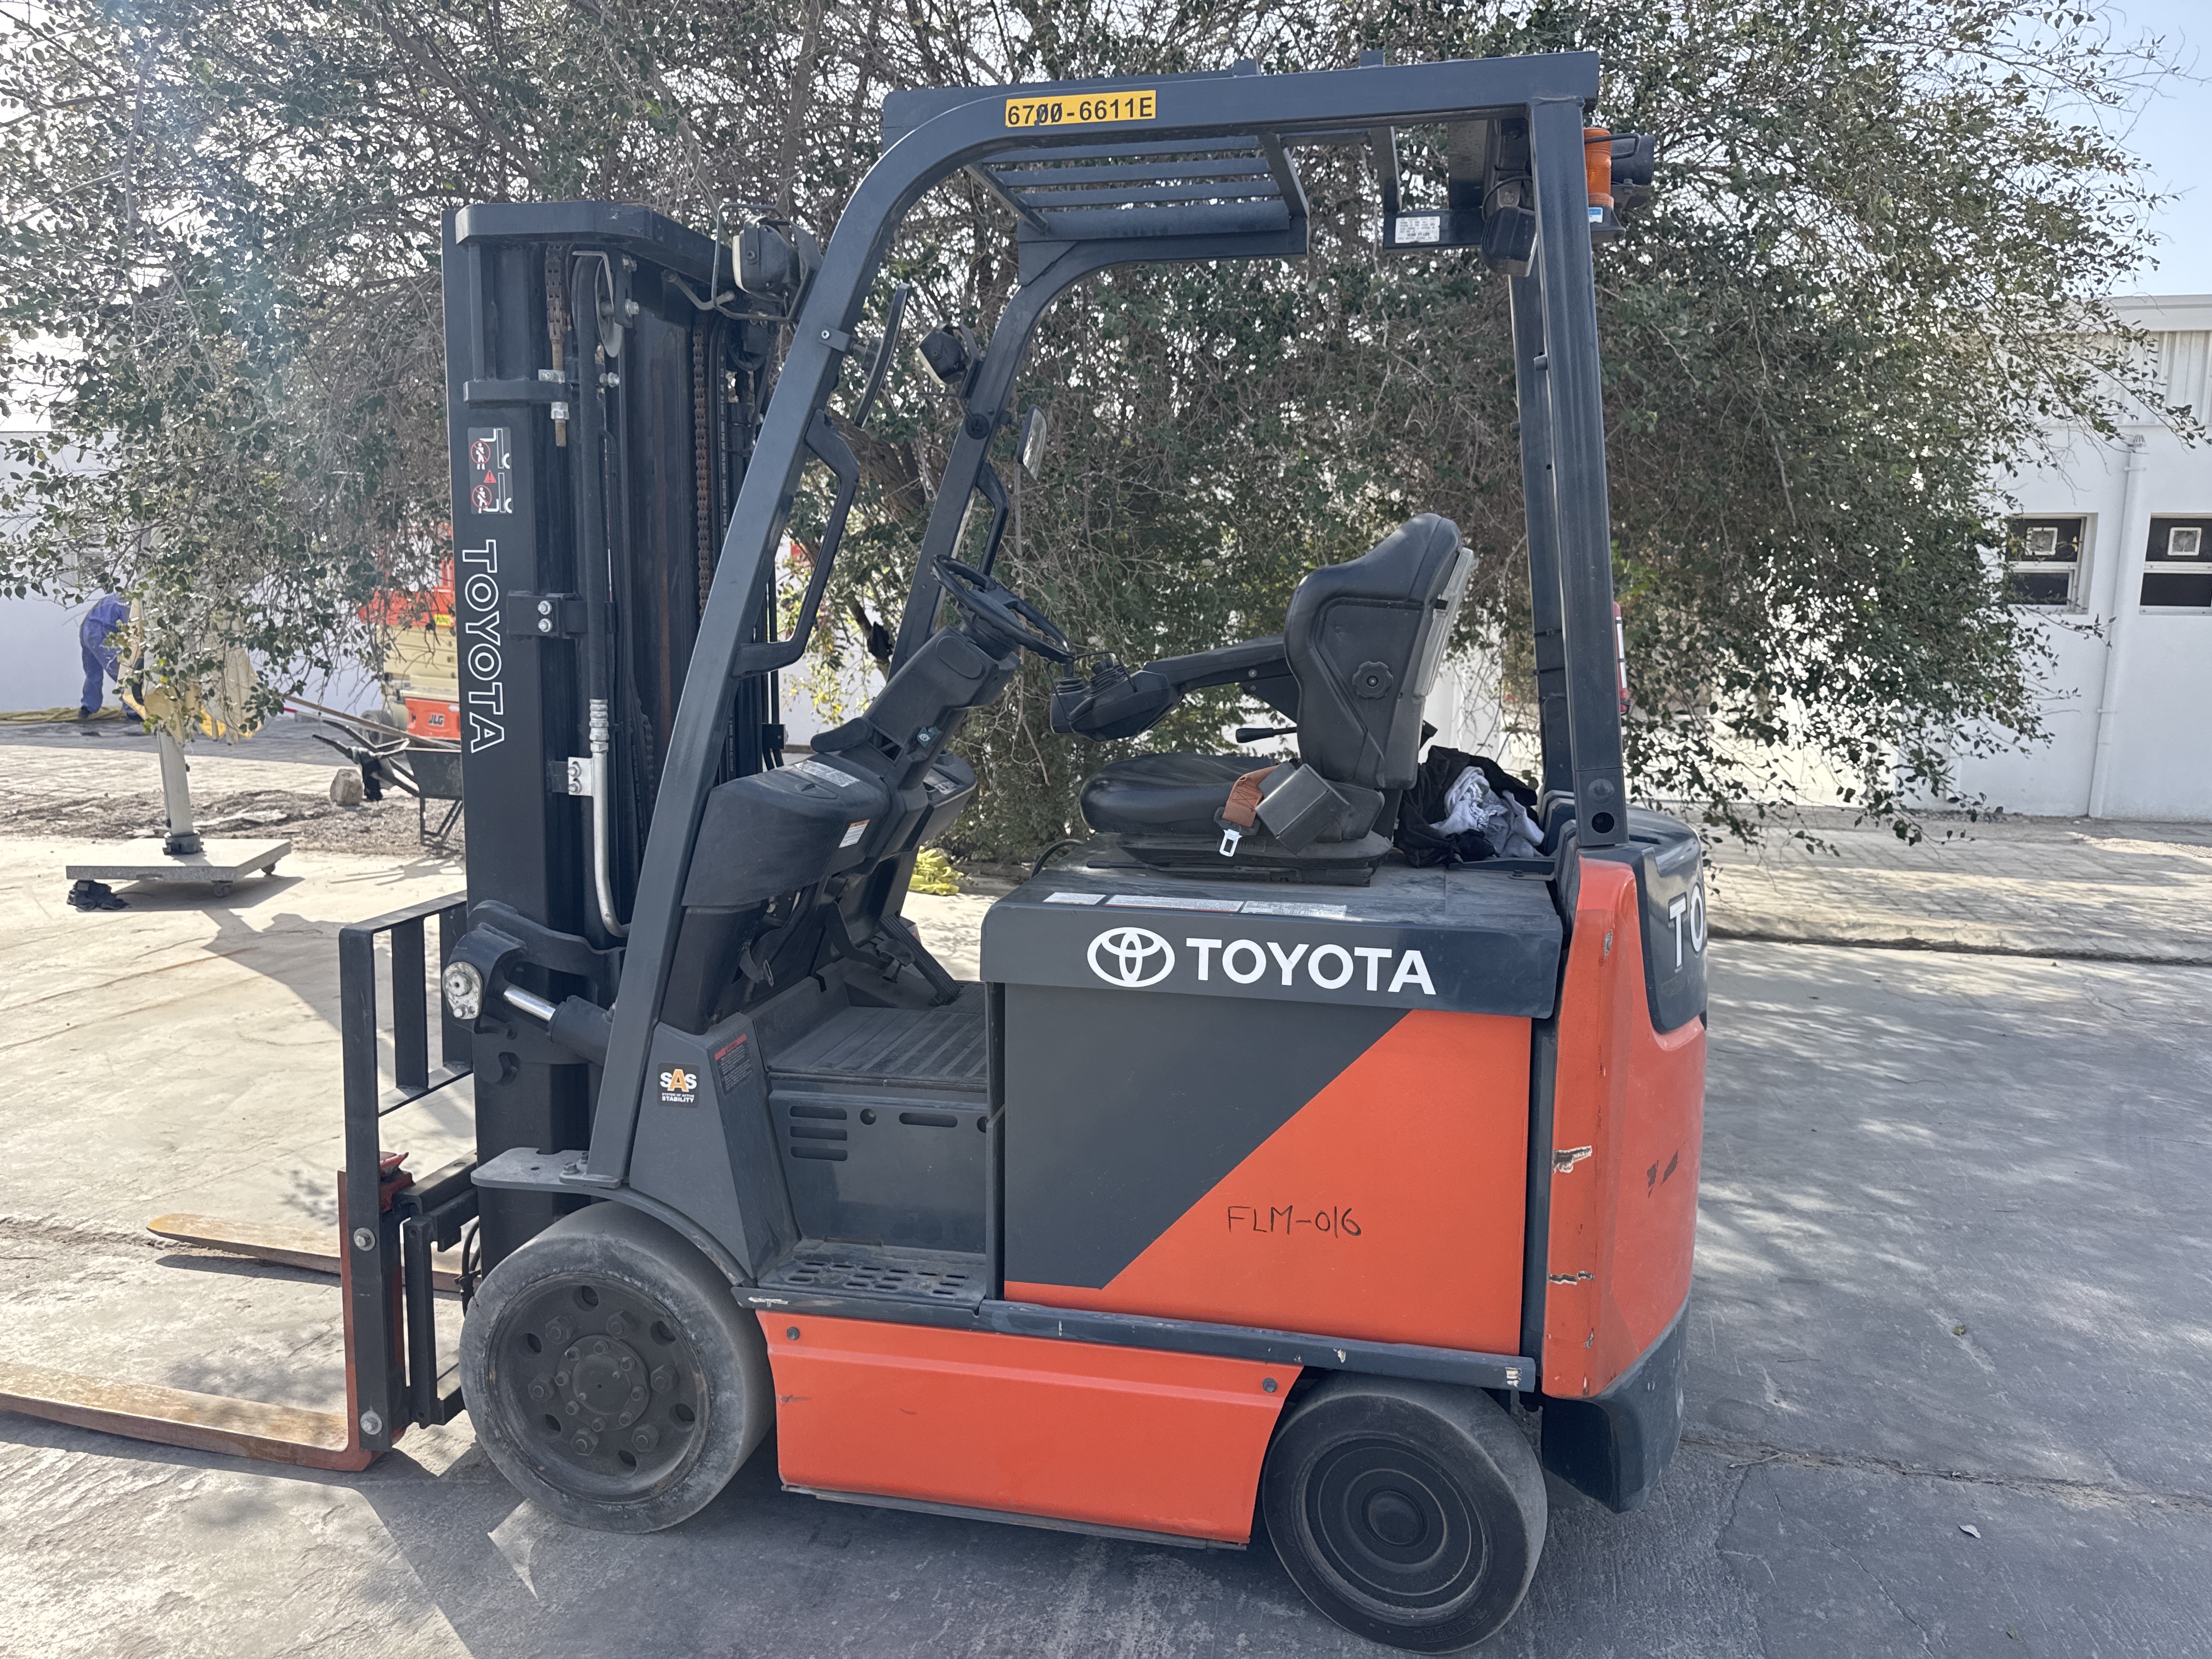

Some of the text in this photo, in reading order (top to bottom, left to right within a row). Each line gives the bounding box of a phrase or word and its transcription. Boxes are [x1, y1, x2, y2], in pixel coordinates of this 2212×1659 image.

[1007, 97, 1153, 125] 6700-6611E
[462, 539, 505, 753] TOYOTA
[428, 714, 444, 725] JLG
[1186, 937, 1436, 995] TOYOTA
[660, 1069, 697, 1092] SAS
[1228, 1205, 1362, 1239] FLM-016
[1413, 1608, 1486, 1642] SOLIDEAL
